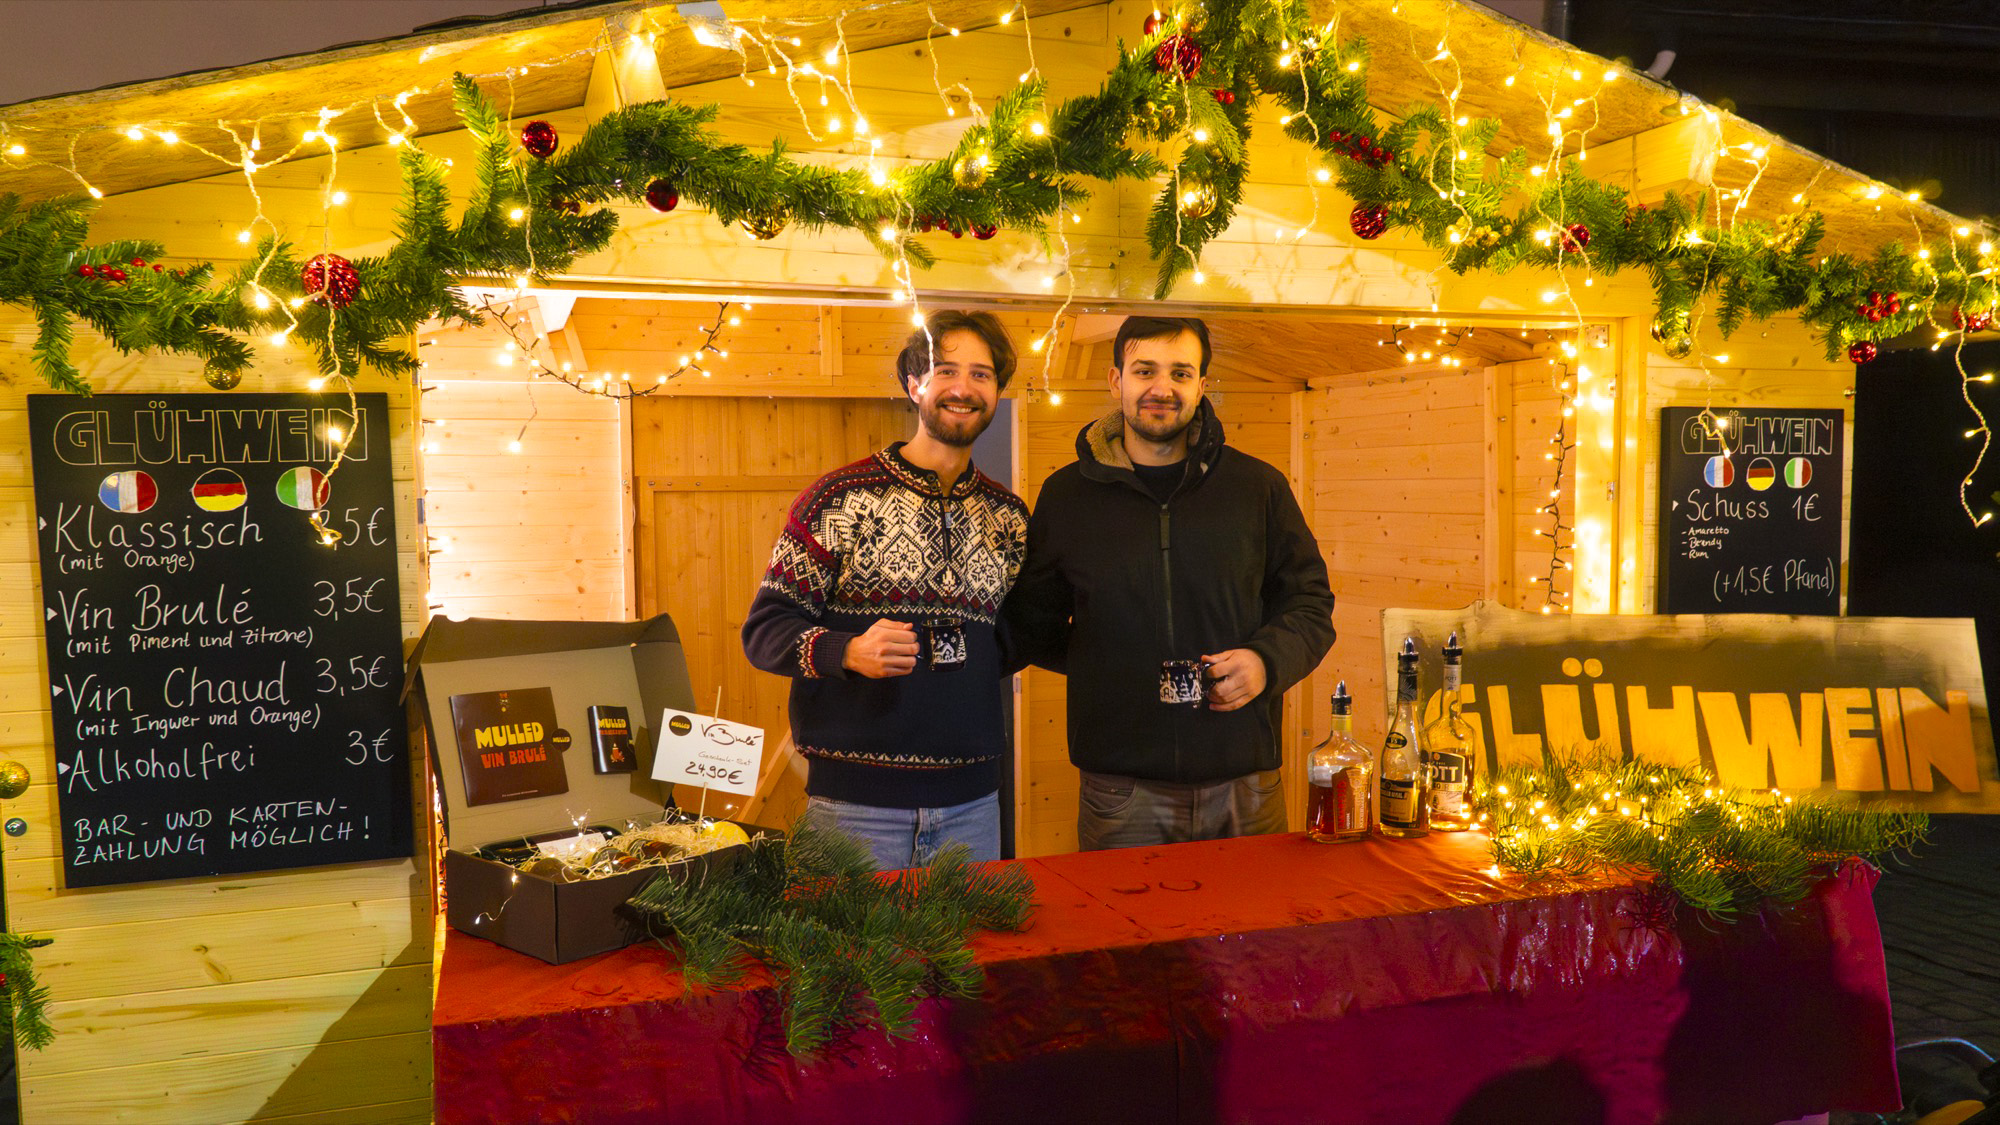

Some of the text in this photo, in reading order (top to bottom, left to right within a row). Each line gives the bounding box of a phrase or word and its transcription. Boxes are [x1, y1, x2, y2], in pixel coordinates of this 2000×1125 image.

[53, 400, 368, 466] GLÜHWEIN
[1681, 410, 1834, 456] GLÜHWEIN
[1686, 488, 1823, 522] Schuss 1€
[55, 501, 264, 553] Klassisch
[59, 549, 196, 575] (mit Orange)
[1783, 556, 1835, 597] Pfand)
[57, 577, 387, 636] Vin Brulé 3,5€
[65, 637, 112, 658] (mit
[130, 633, 192, 653] Piment
[200, 631, 234, 650] und
[64, 655, 390, 715] Vin Chaud 3,5€
[75, 703, 322, 741] (mit Ingwer und Orange)
[474, 722, 545, 750] MULLED
[597, 718, 627, 729] MULLED
[1423, 657, 1981, 794] GLÜHWEIN
[67, 742, 256, 794] Alkoholfrei
[480, 744, 547, 769] VIN BRULÉ
[165, 808, 213, 831] UND
[228, 798, 349, 826] KARTEN-
[73, 835, 206, 866] ZAHLUNG
